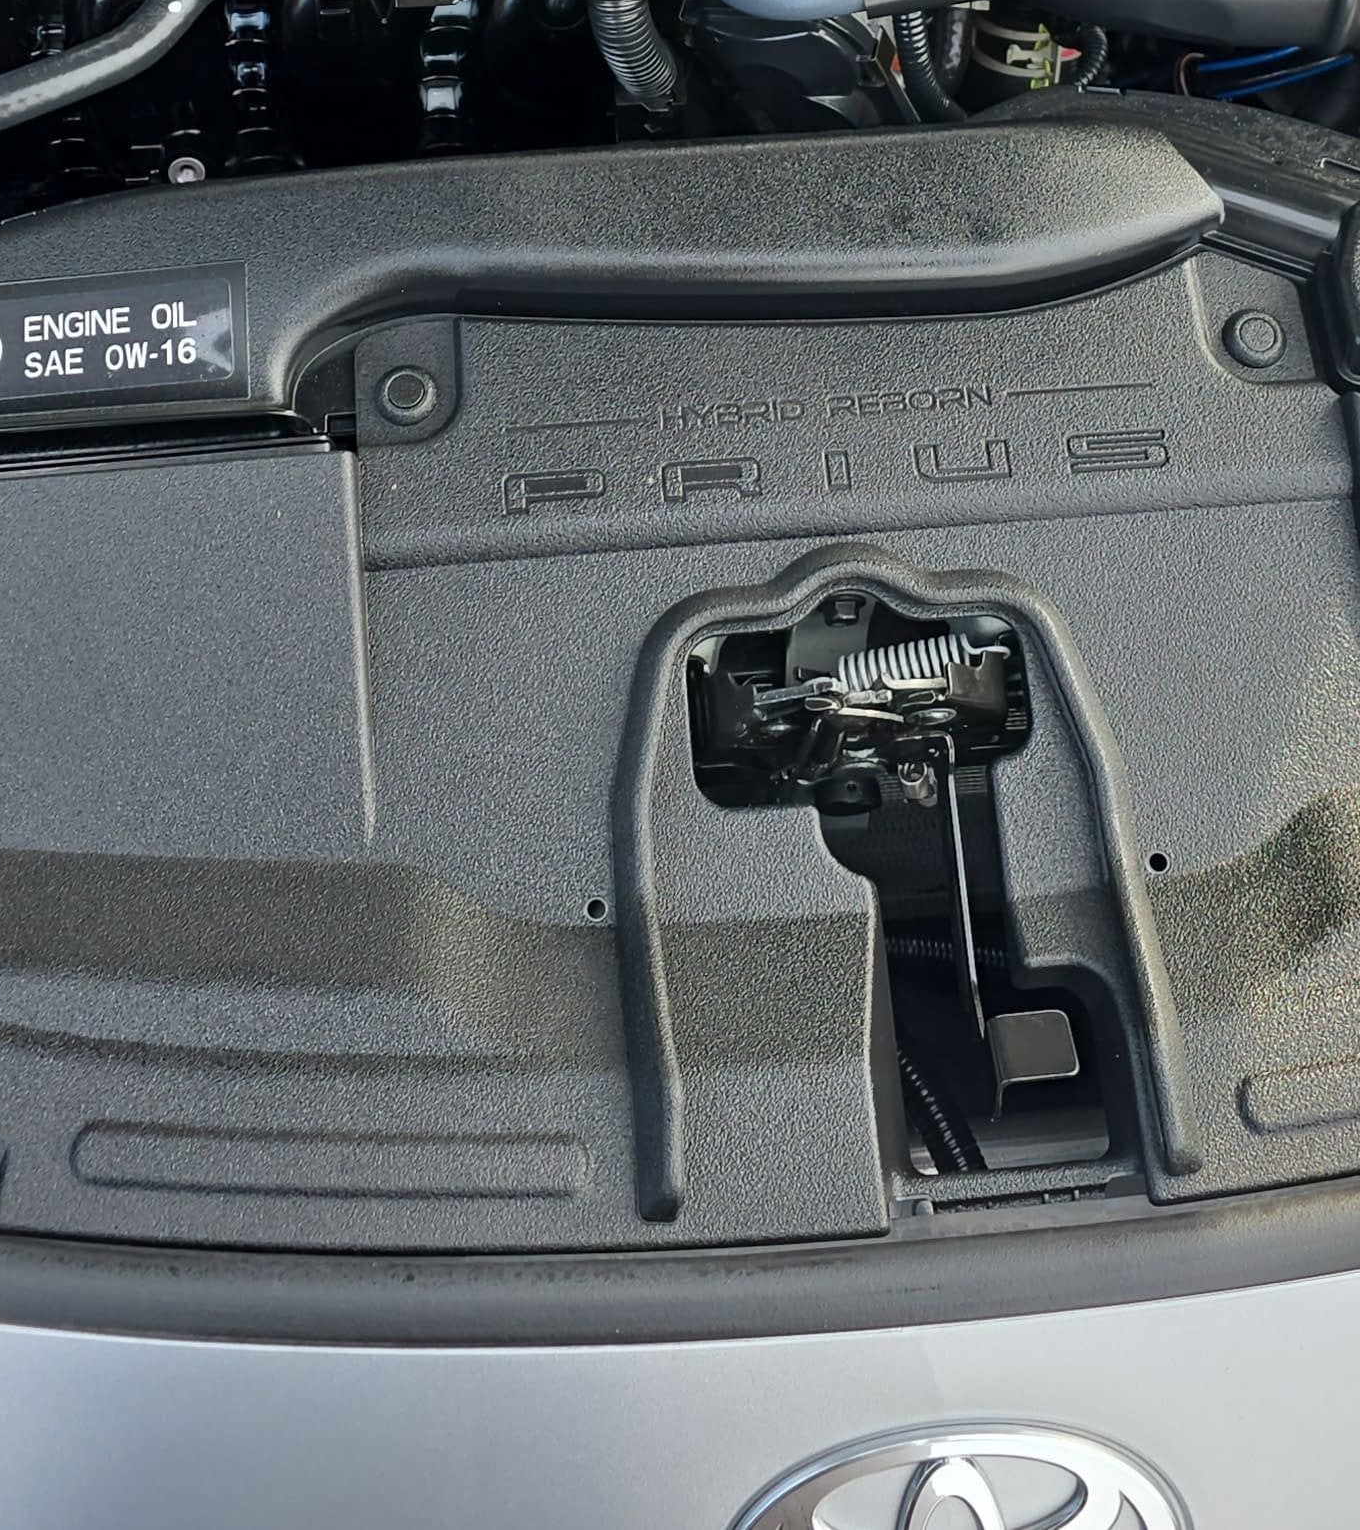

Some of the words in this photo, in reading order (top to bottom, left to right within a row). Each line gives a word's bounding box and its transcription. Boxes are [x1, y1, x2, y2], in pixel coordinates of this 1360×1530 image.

[23, 306, 131, 343] ENGINE
[150, 301, 198, 330] OIL
[24, 347, 84, 379] SAE
[104, 336, 197, 371] 0W-16
[660, 396, 806, 431] HYBRID
[825, 384, 993, 419] REBORN
[502, 428, 1169, 517] PRIUS
